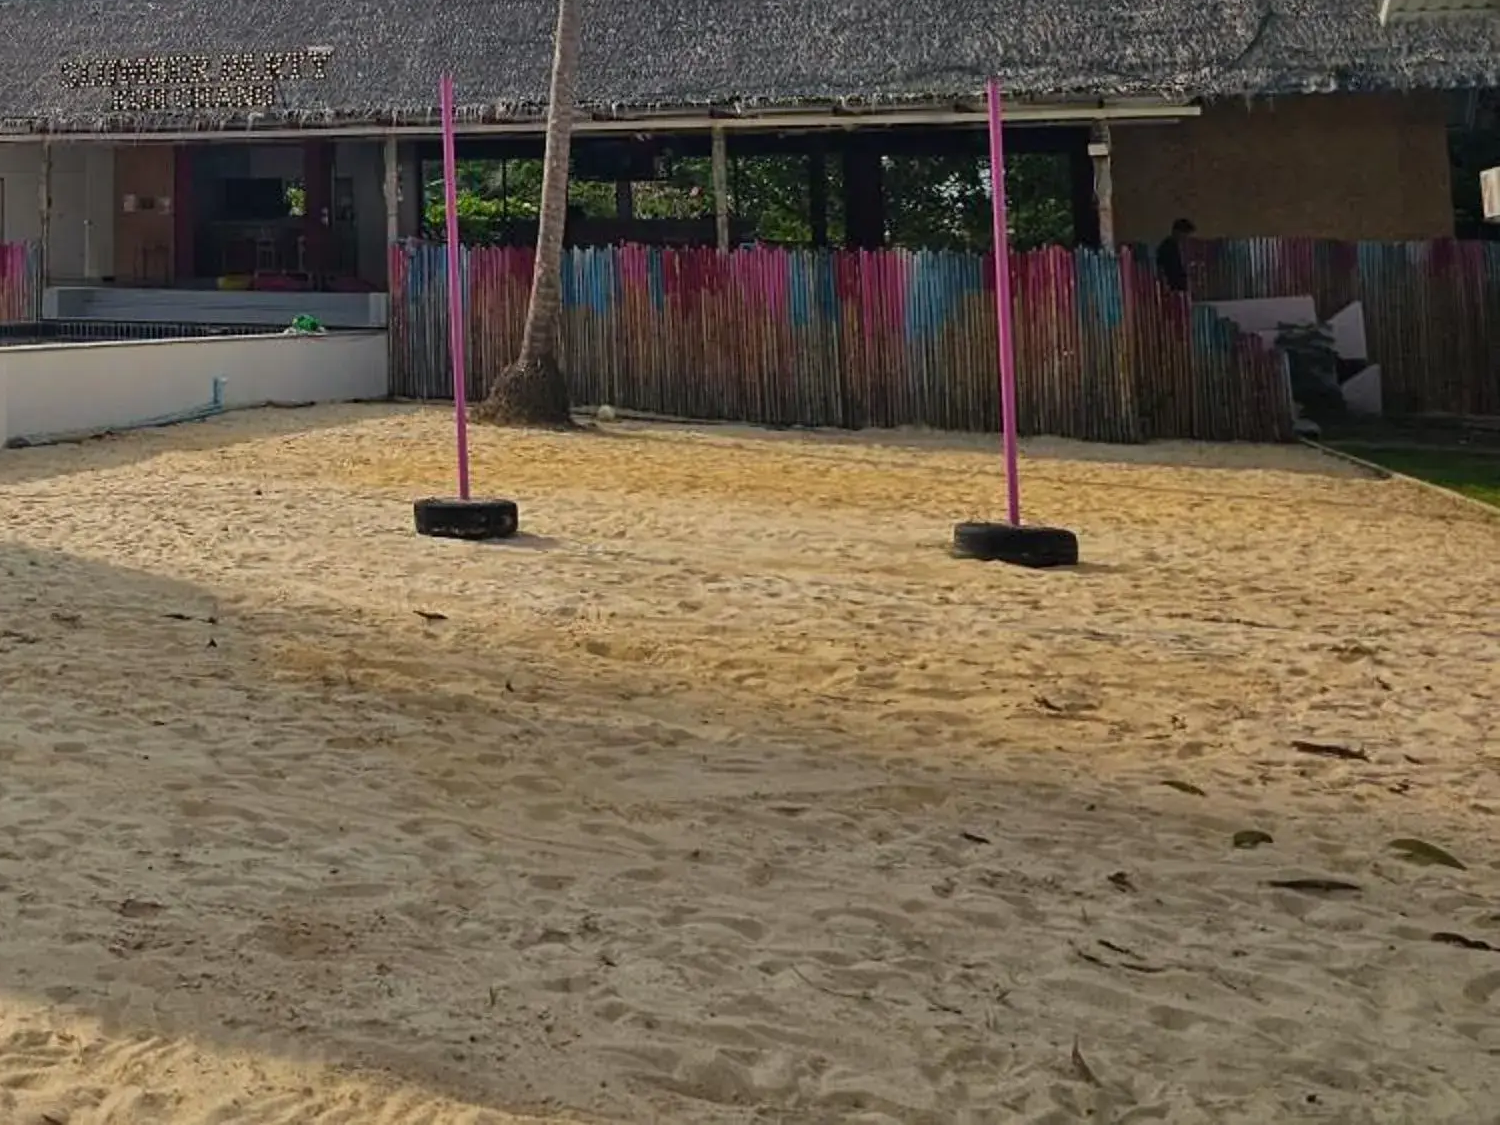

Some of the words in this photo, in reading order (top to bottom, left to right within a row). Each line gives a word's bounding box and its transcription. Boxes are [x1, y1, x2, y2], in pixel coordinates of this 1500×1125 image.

[60, 55, 211, 89] SLUMBER
[219, 49, 334, 81] PARTY
[111, 88, 166, 111] KOH
